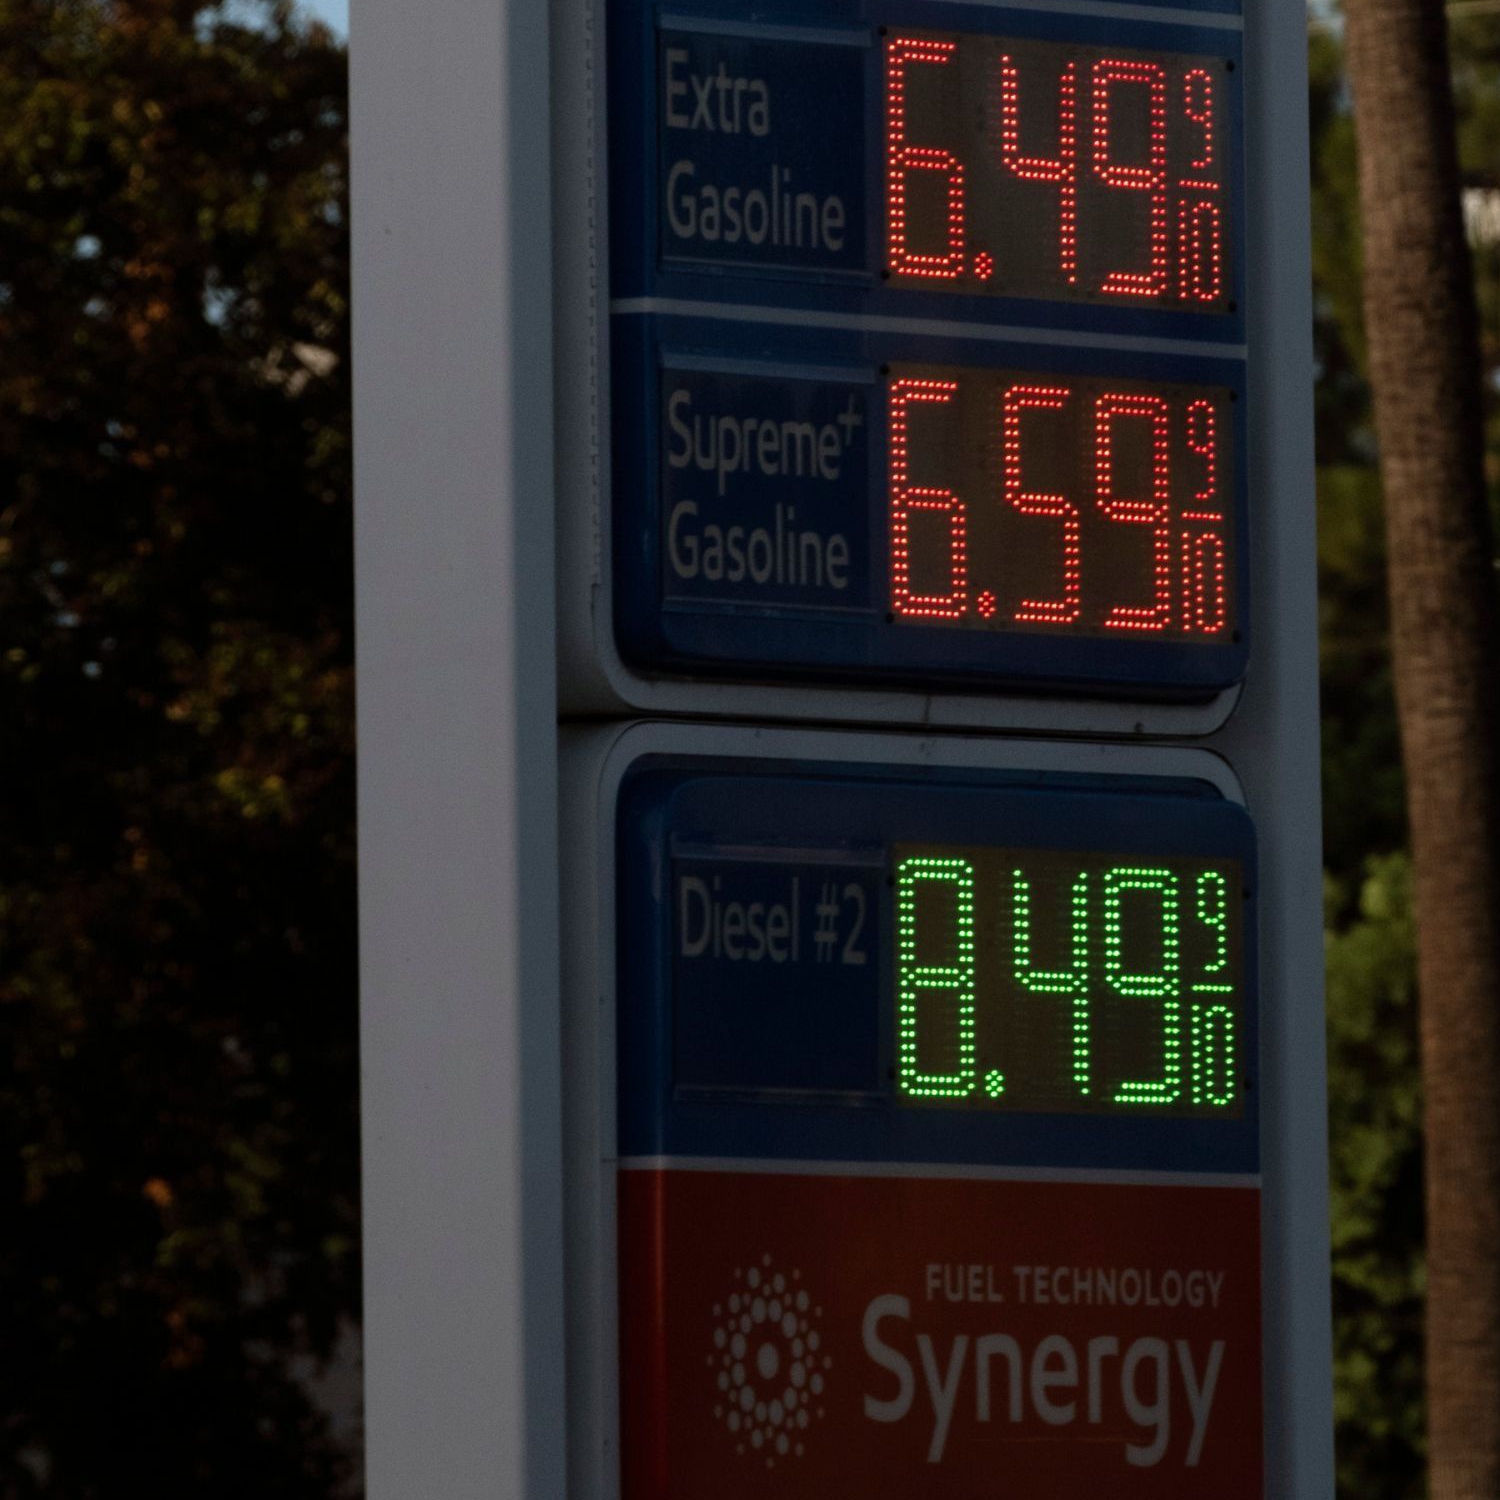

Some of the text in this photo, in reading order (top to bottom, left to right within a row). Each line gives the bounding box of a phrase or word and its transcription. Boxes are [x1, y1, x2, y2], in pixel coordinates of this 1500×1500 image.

[665, 49, 770, 137] Extra
[667, 160, 845, 252] Gasoline
[888, 38, 1168, 297] 6.49
[668, 500, 850, 590] Gasoline
[890, 380, 1170, 630] 6.59
[680, 876, 868, 966] Diesel #2
[898, 858, 1181, 1104] 8.49
[925, 1263, 1225, 1308] FUEL TECHNOLOGY
[861, 1294, 1226, 1467] Synergy
